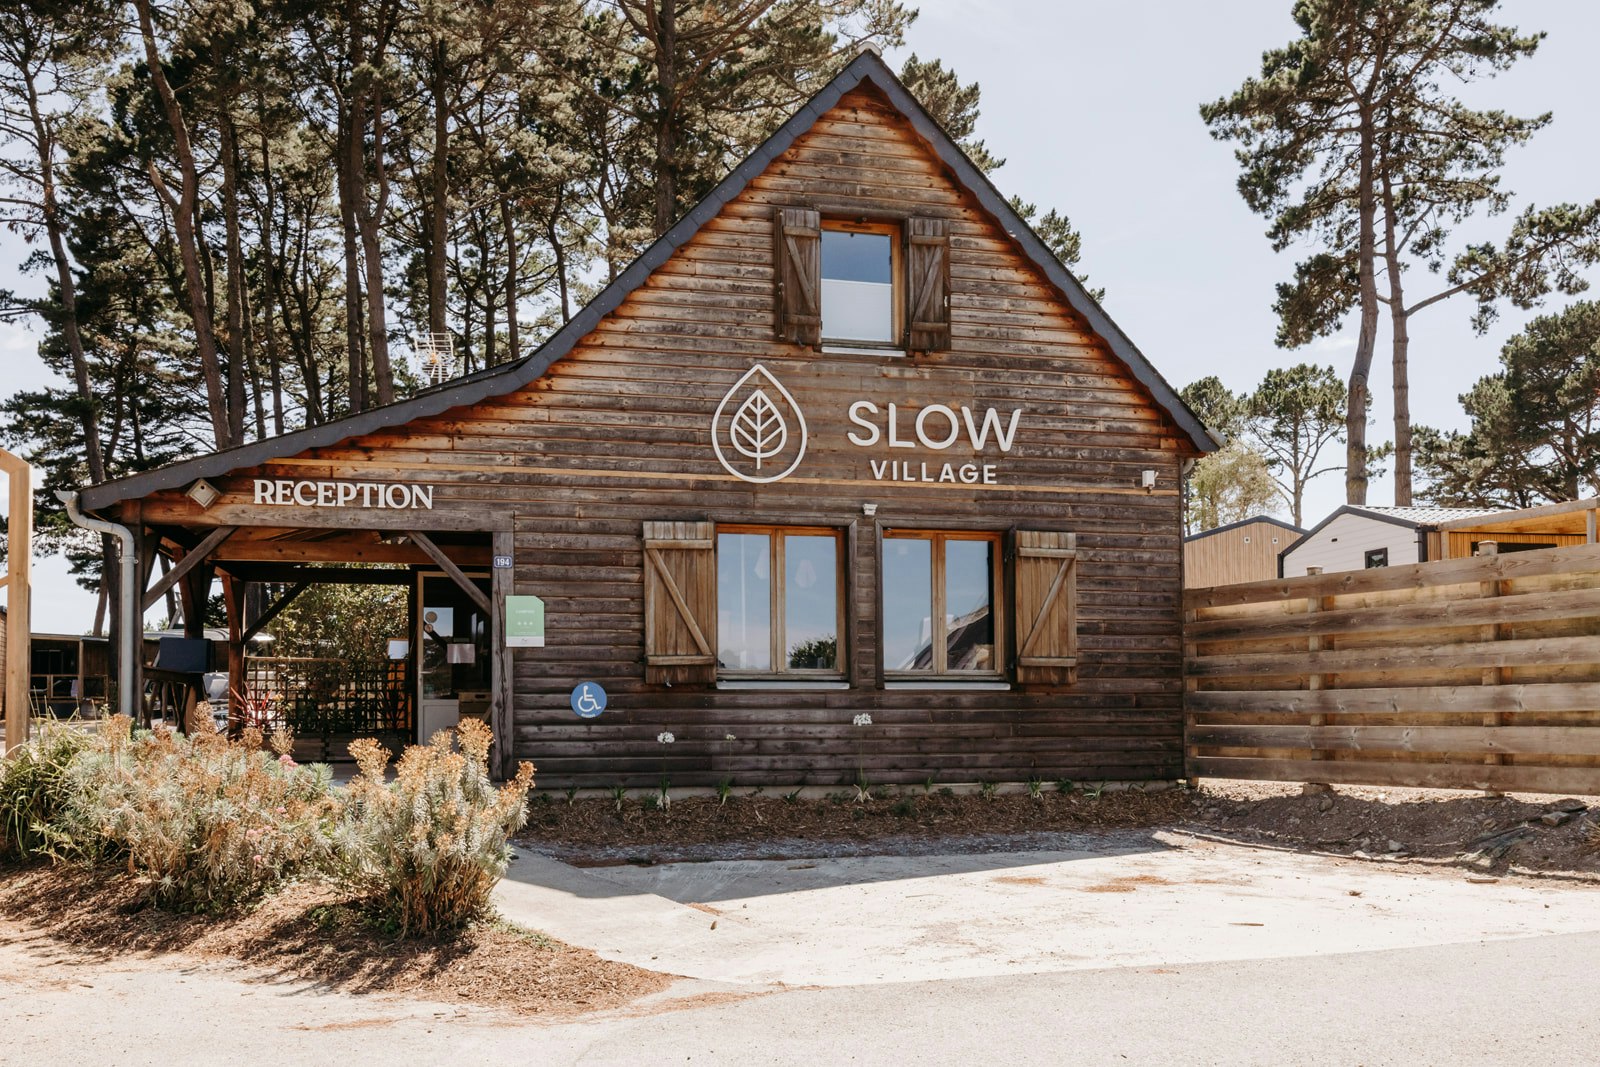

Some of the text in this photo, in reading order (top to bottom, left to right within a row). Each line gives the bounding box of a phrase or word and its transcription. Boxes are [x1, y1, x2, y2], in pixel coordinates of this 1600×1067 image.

[847, 400, 1022, 452] SLOW
[870, 460, 998, 485] VILLAGE
[253, 479, 434, 510] RECEPTION
[496, 558, 510, 566] 194
